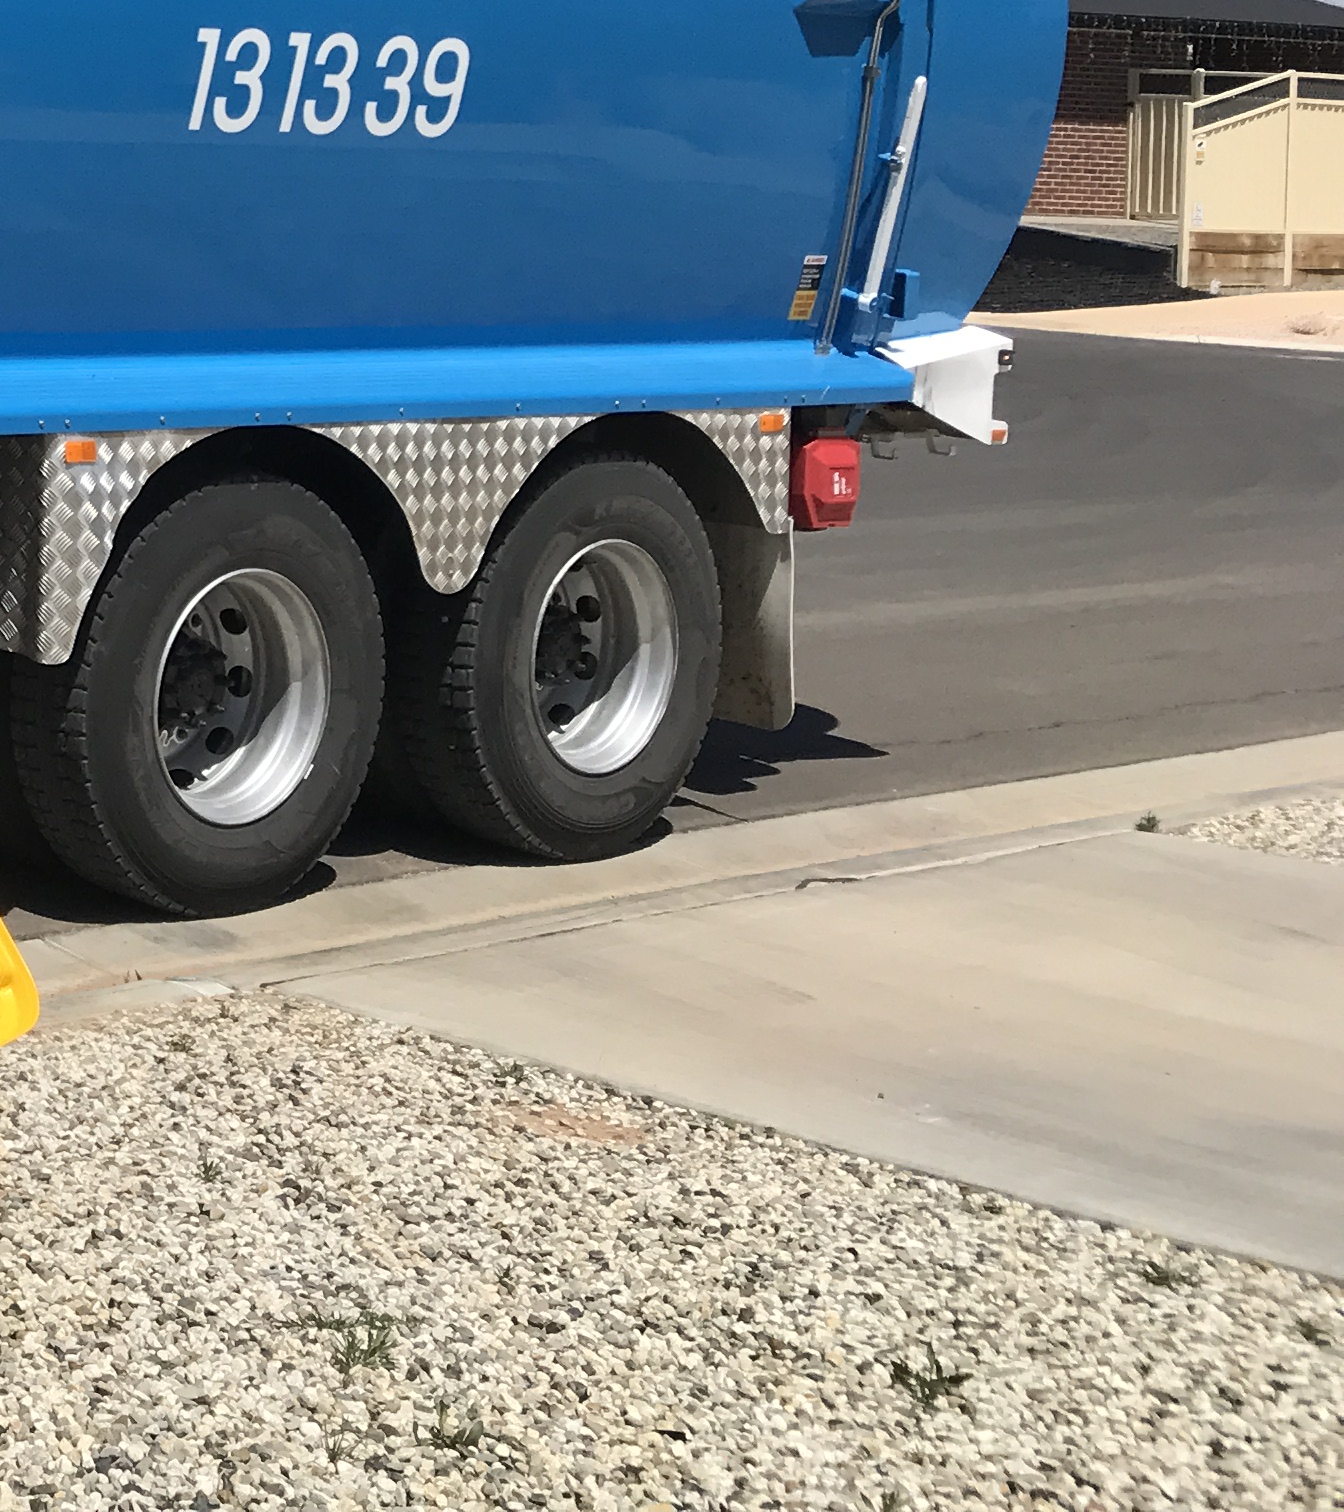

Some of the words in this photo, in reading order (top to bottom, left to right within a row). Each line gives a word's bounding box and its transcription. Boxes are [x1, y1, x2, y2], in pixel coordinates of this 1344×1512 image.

[188, 27, 271, 134] 13
[279, 32, 359, 136] 13
[364, 36, 471, 138] 39
